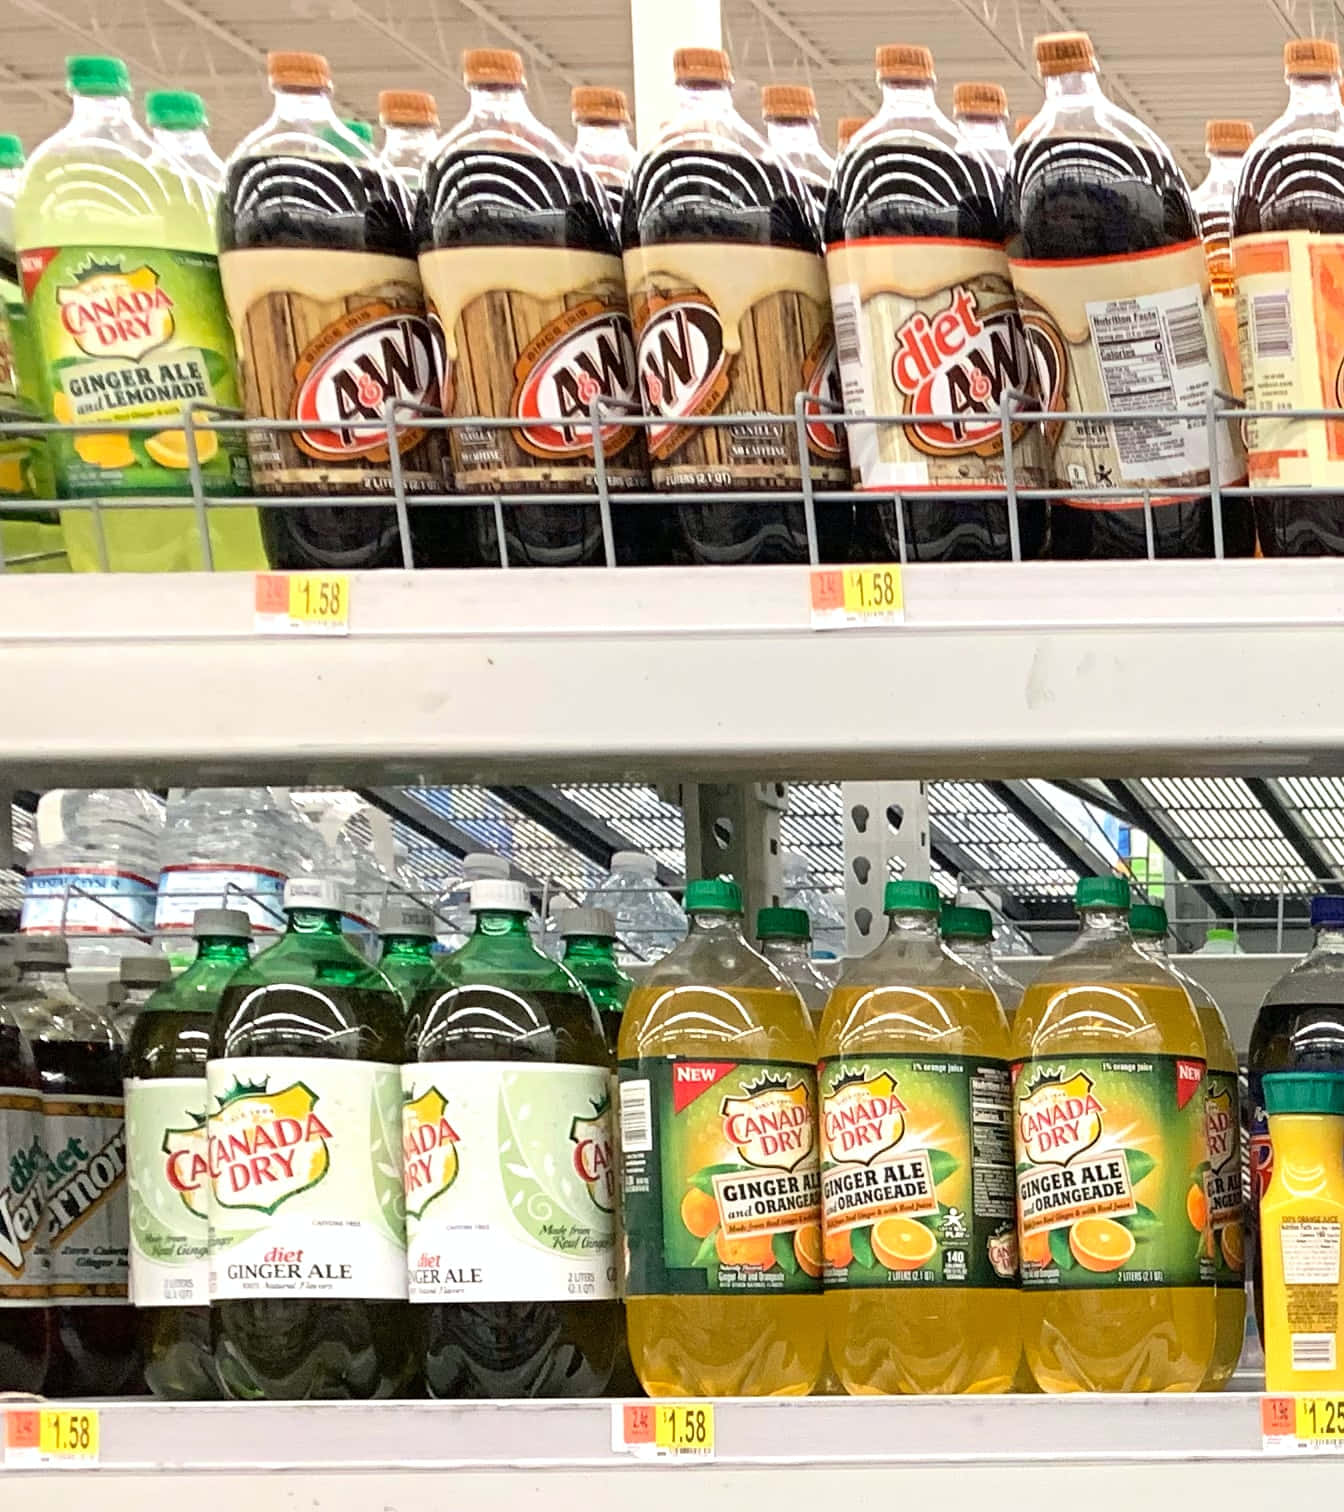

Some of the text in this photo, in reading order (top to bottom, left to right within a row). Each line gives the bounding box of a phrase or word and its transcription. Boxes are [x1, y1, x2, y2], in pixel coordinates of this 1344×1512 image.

[61, 287, 174, 335] CANADA
[94, 313, 154, 347] DRY
[900, 287, 986, 379] diet
[69, 362, 201, 399] GINGER ALE
[104, 380, 207, 408] LEMONADE
[332, 320, 418, 444] A&W
[552, 317, 634, 443] A&W
[943, 325, 1029, 440] A&W
[676, 1067, 717, 1083] NEW
[722, 1105, 812, 1145] CANADA
[823, 1095, 908, 1141] CANADA
[841, 1118, 885, 1152] DRY
[1020, 1095, 1104, 1141] CANADA
[1037, 1119, 1081, 1152] DRY
[207, 1113, 333, 1177] CANADA
[760, 1127, 803, 1156] DRY
[230, 1153, 296, 1194] DRY
[722, 1177, 798, 1202] GINGER
[824, 1161, 925, 1198] GINGER ALE
[1020, 1161, 1123, 1199] GINGER ALE
[838, 1179, 929, 1211] ORANGEADE
[1035, 1180, 1126, 1212] ORANGEADE
[227, 1263, 352, 1281] GINGER ALE
[264, 1246, 304, 1263] diet
[946, 1251, 965, 1263] 140
[444, 1268, 482, 1284] ALE
